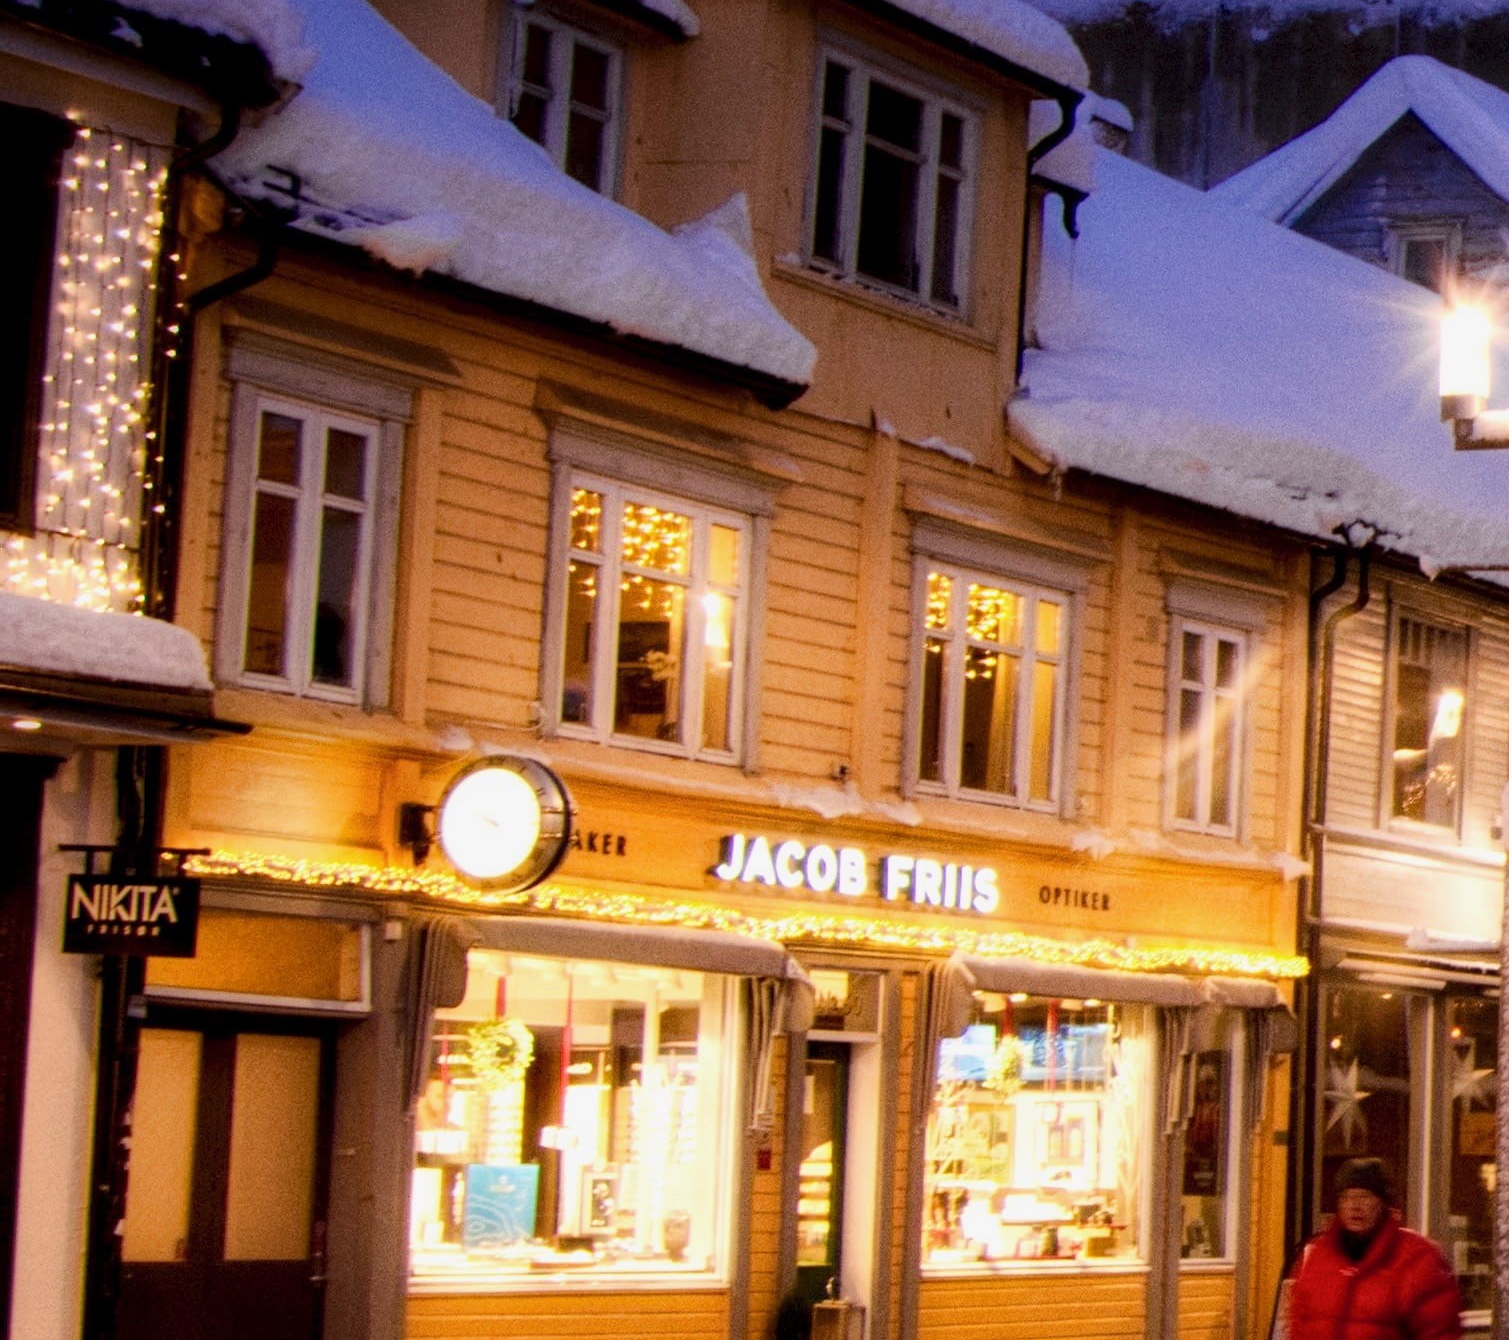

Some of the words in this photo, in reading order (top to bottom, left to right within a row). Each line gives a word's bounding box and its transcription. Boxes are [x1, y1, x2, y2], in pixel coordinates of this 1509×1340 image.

[570, 829, 628, 857] AKER
[713, 832, 868, 897] JACOB
[882, 853, 1000, 914] FRIIS
[70, 881, 179, 923] NIKITA
[1039, 885, 1110, 911] OPTIKER
